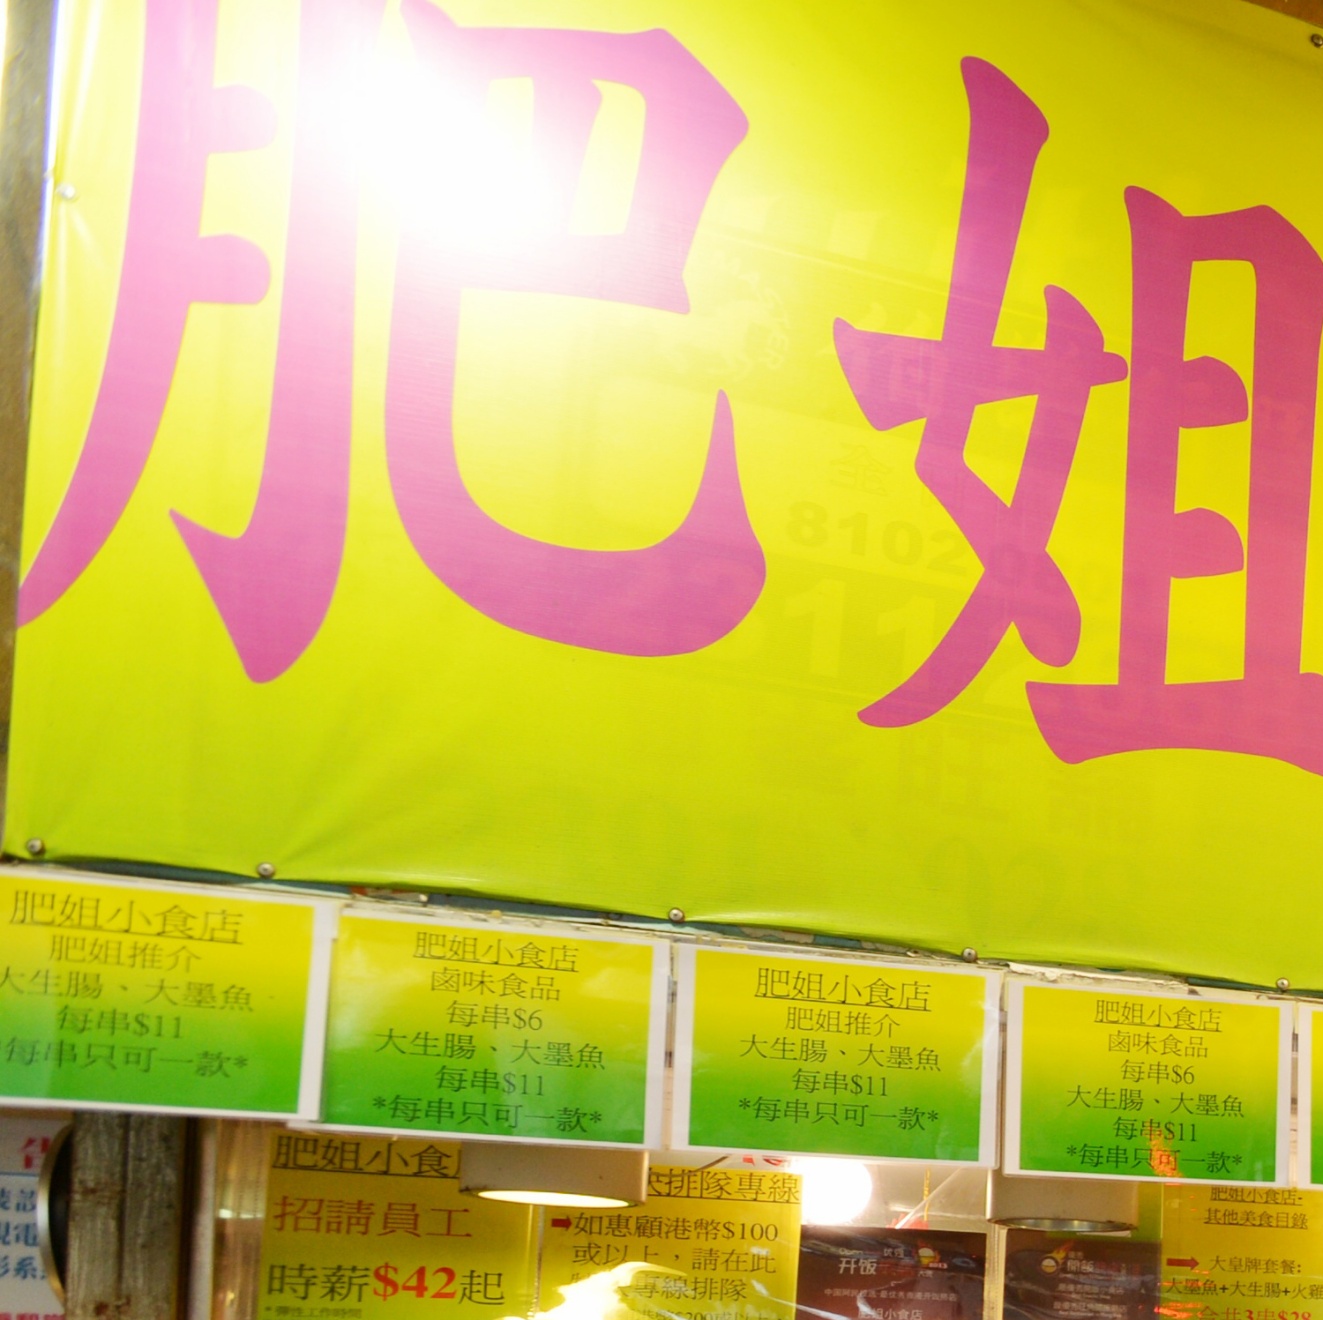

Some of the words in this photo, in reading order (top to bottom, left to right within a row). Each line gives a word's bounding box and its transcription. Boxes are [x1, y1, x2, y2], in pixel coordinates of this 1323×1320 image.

[8, 889, 243, 944] 肥姐小食店
[49, 933, 203, 974] 肥姐推介
[413, 931, 580, 973] 肥姐小食店
[429, 967, 562, 1001] 鹵味食品
[754, 966, 932, 1012] 肥姐小食店
[56, 1003, 184, 1041] 每串$11
[446, 1000, 544, 1032] 每串$6
[785, 1004, 901, 1039] 肥姐推介
[1094, 999, 1223, 1034] 肥姐小食店
[375, 1028, 606, 1071] 大生腸、大墨魚
[740, 1033, 942, 1074] 大生腸、大墨魚
[1107, 1031, 1210, 1060] 鹵味食品
[435, 1065, 545, 1097] 每串$11
[792, 1067, 889, 1099] 每串$11
[1120, 1059, 1196, 1087] 每串$6
[1066, 1084, 1245, 1120] 大生腸、大墨魚
[1113, 1116, 1198, 1144] 每串$11
[271, 1134, 460, 1180] 肥姐小食
[273, 1194, 473, 1238] 招請員工
[1203, 1207, 1309, 1230] 其他美食目錄
[267, 1261, 505, 1306] 時薪$42起
